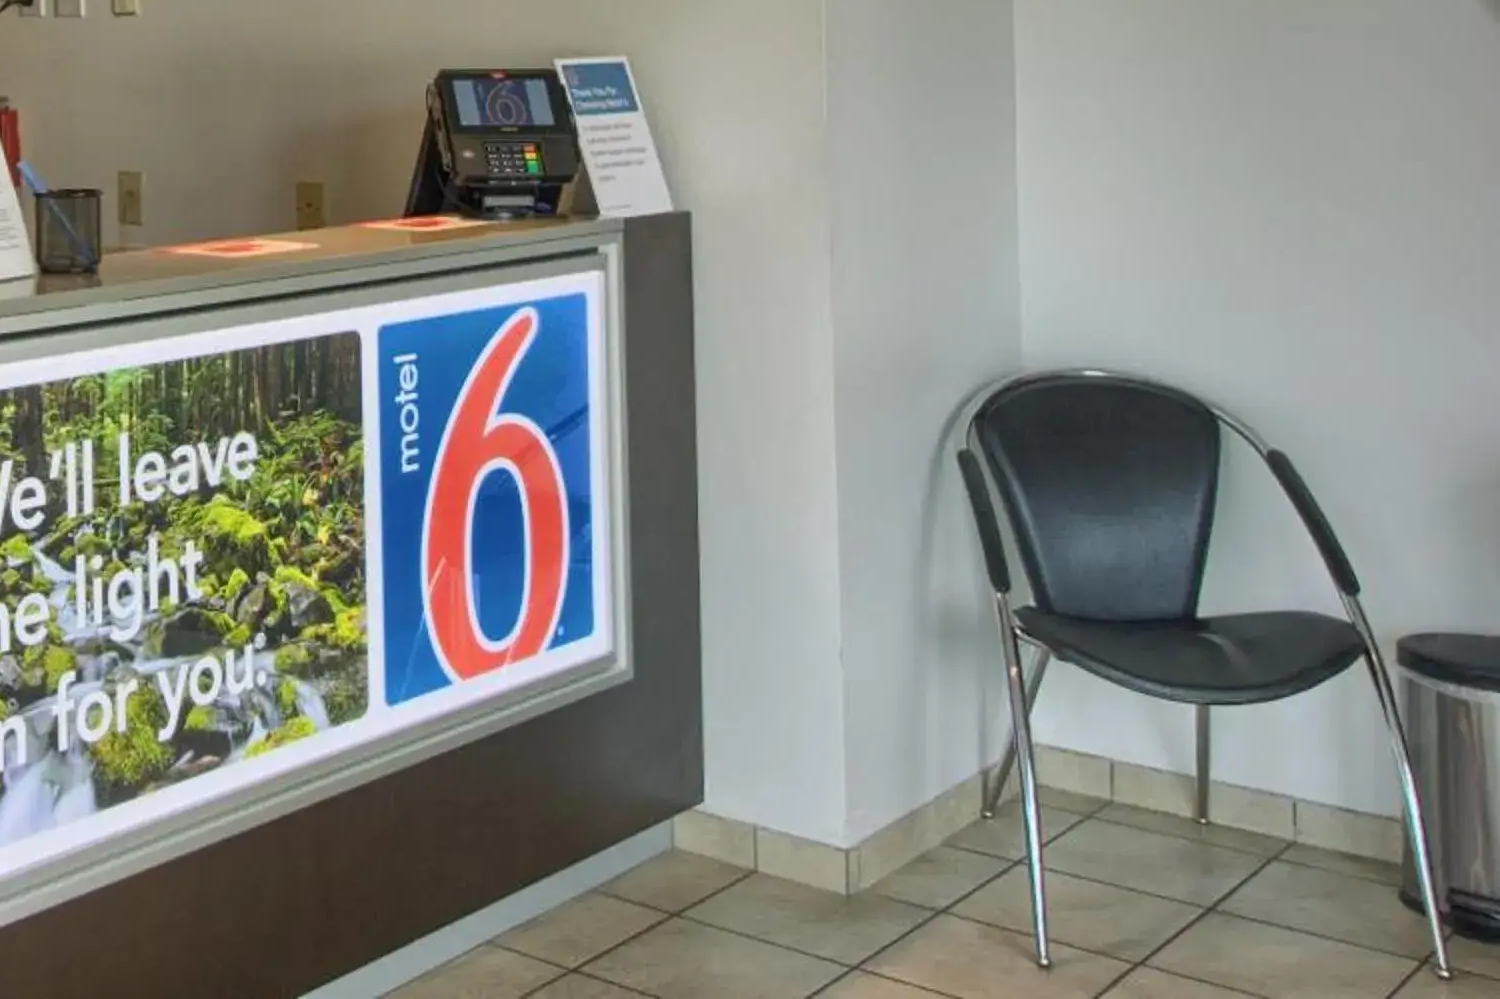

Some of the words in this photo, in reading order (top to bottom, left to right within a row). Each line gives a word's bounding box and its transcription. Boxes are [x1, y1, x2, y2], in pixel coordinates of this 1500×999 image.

[392, 352, 419, 473] motel
[119, 431, 258, 507] leave
[422, 306, 570, 682] 6
[75, 532, 203, 641] light
[53, 670, 138, 752] for
